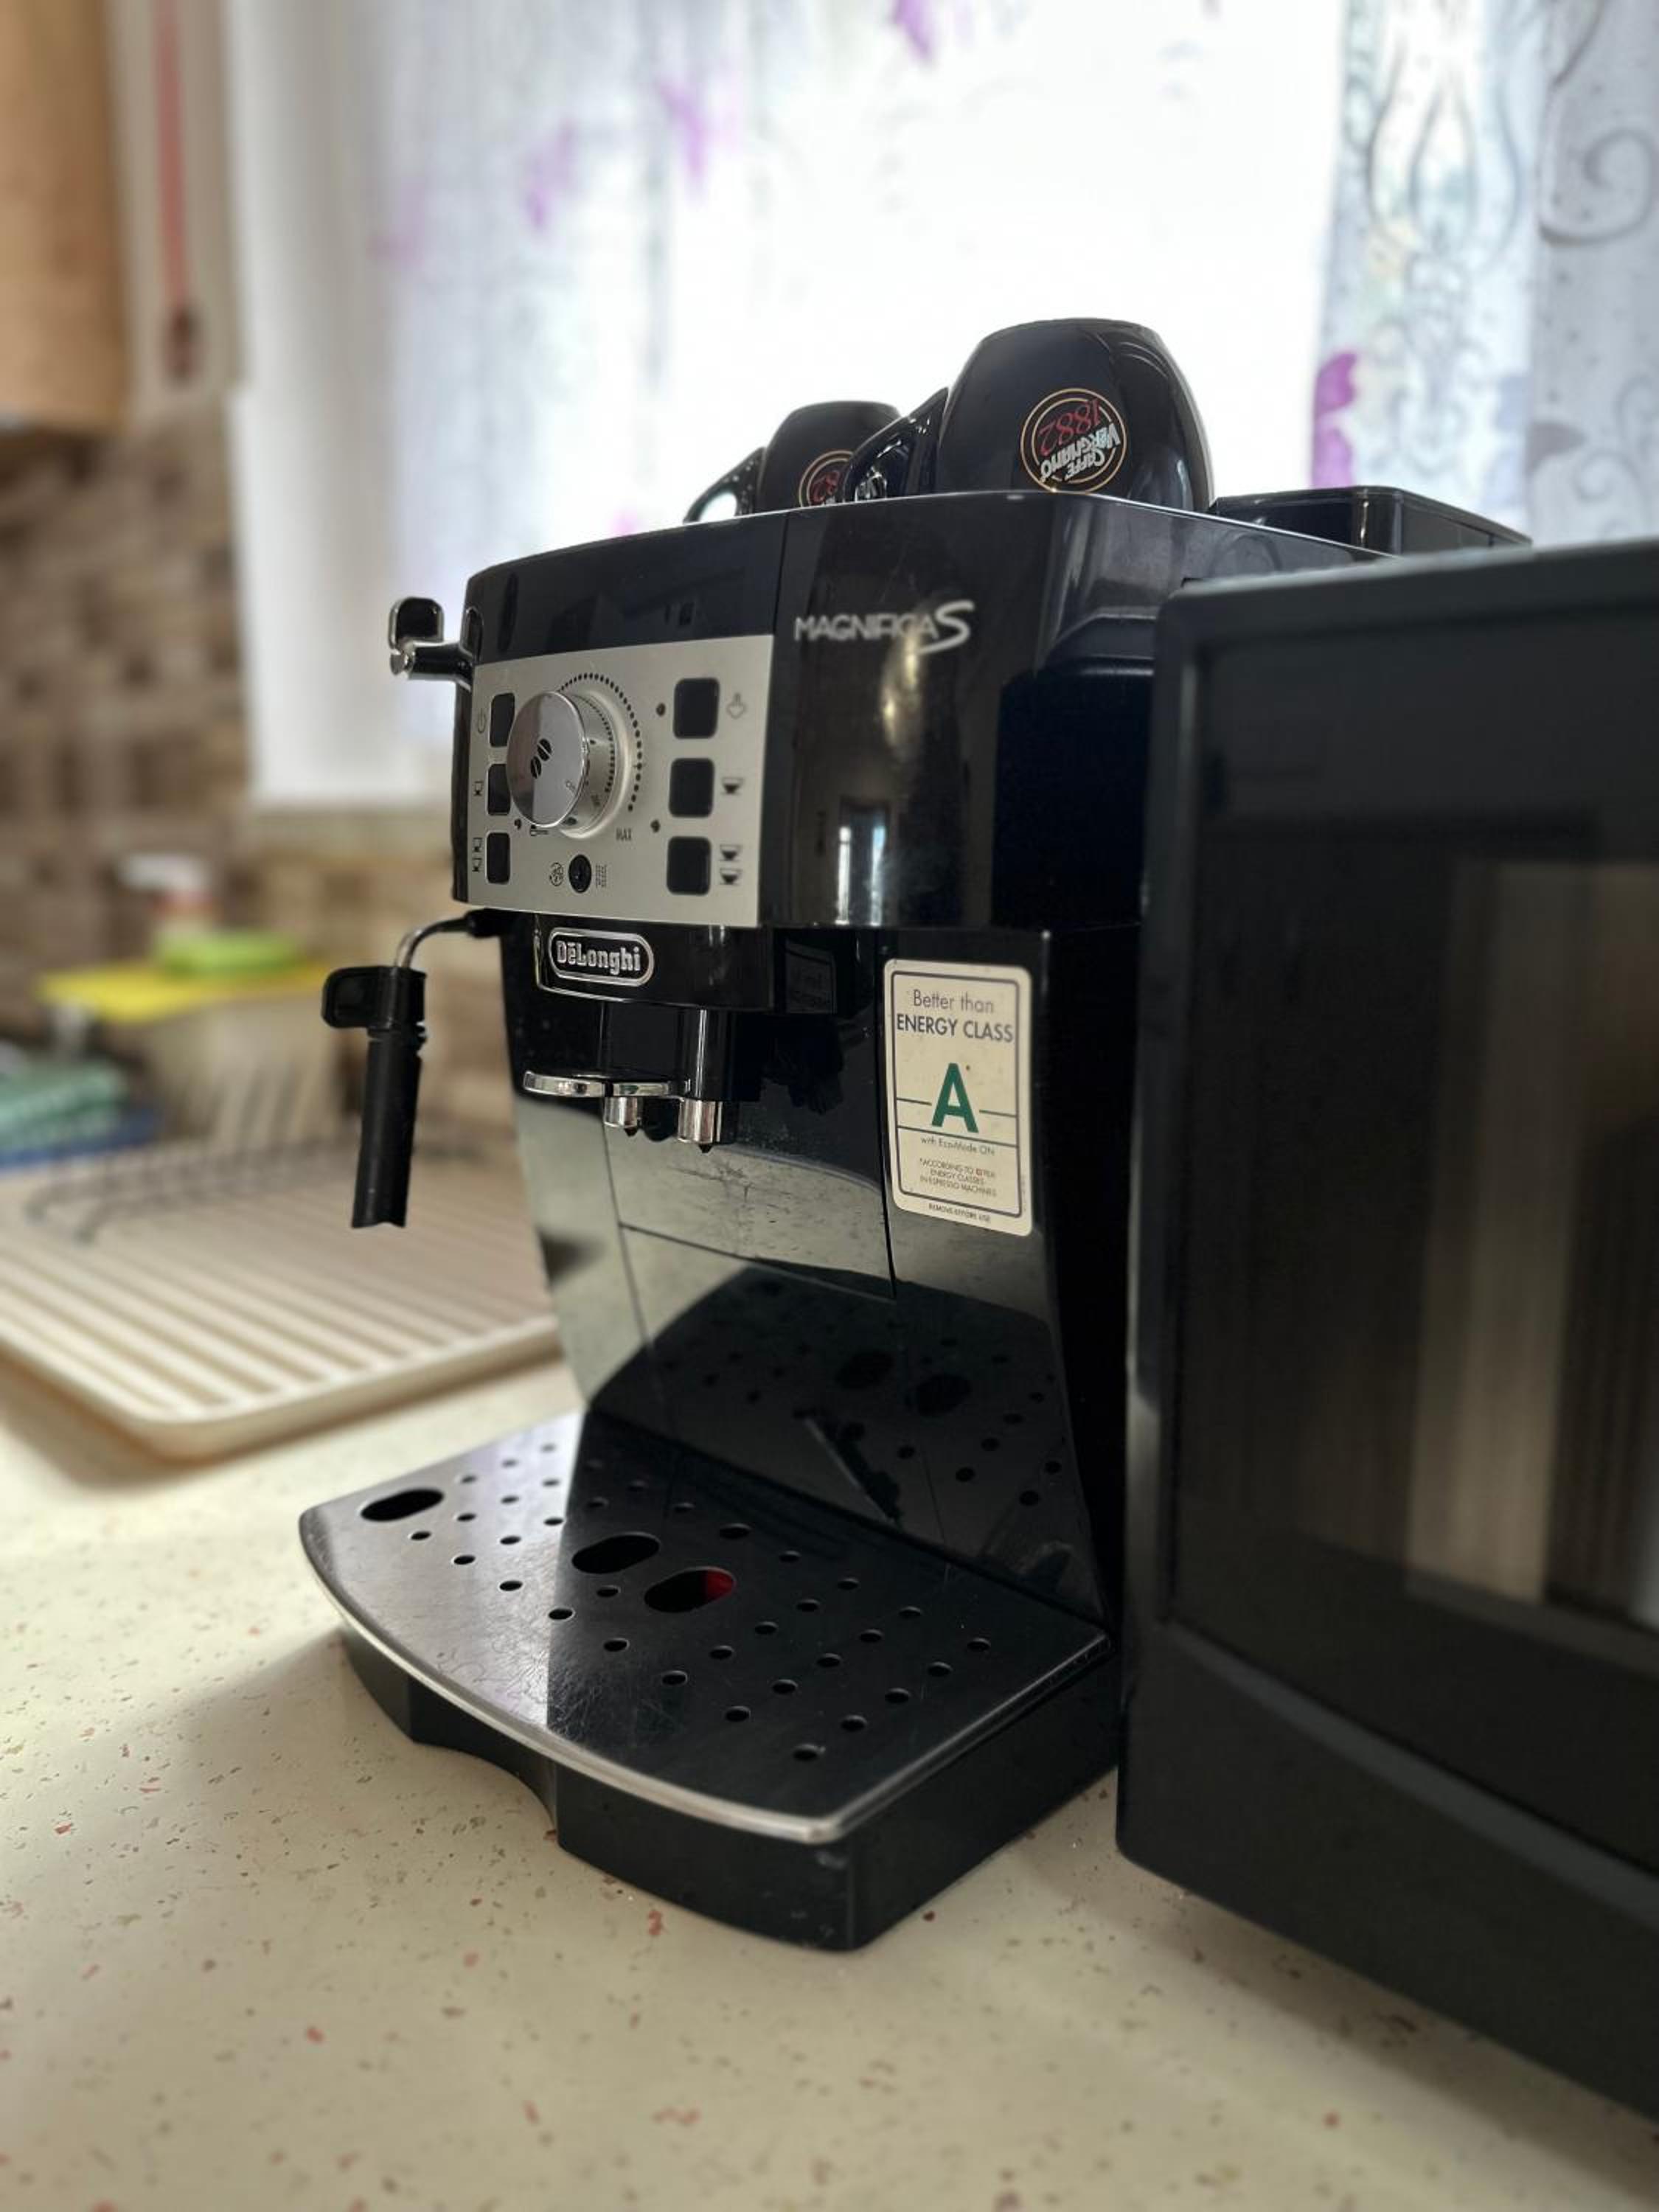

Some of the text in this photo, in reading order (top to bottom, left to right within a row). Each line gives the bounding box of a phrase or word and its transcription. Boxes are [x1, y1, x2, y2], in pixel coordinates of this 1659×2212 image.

[1038, 399, 1100, 456] 1882
[616, 827, 633, 842] MAX
[913, 989, 995, 1013] Better than
[896, 1013, 1014, 1043] ENERGY CLASS
